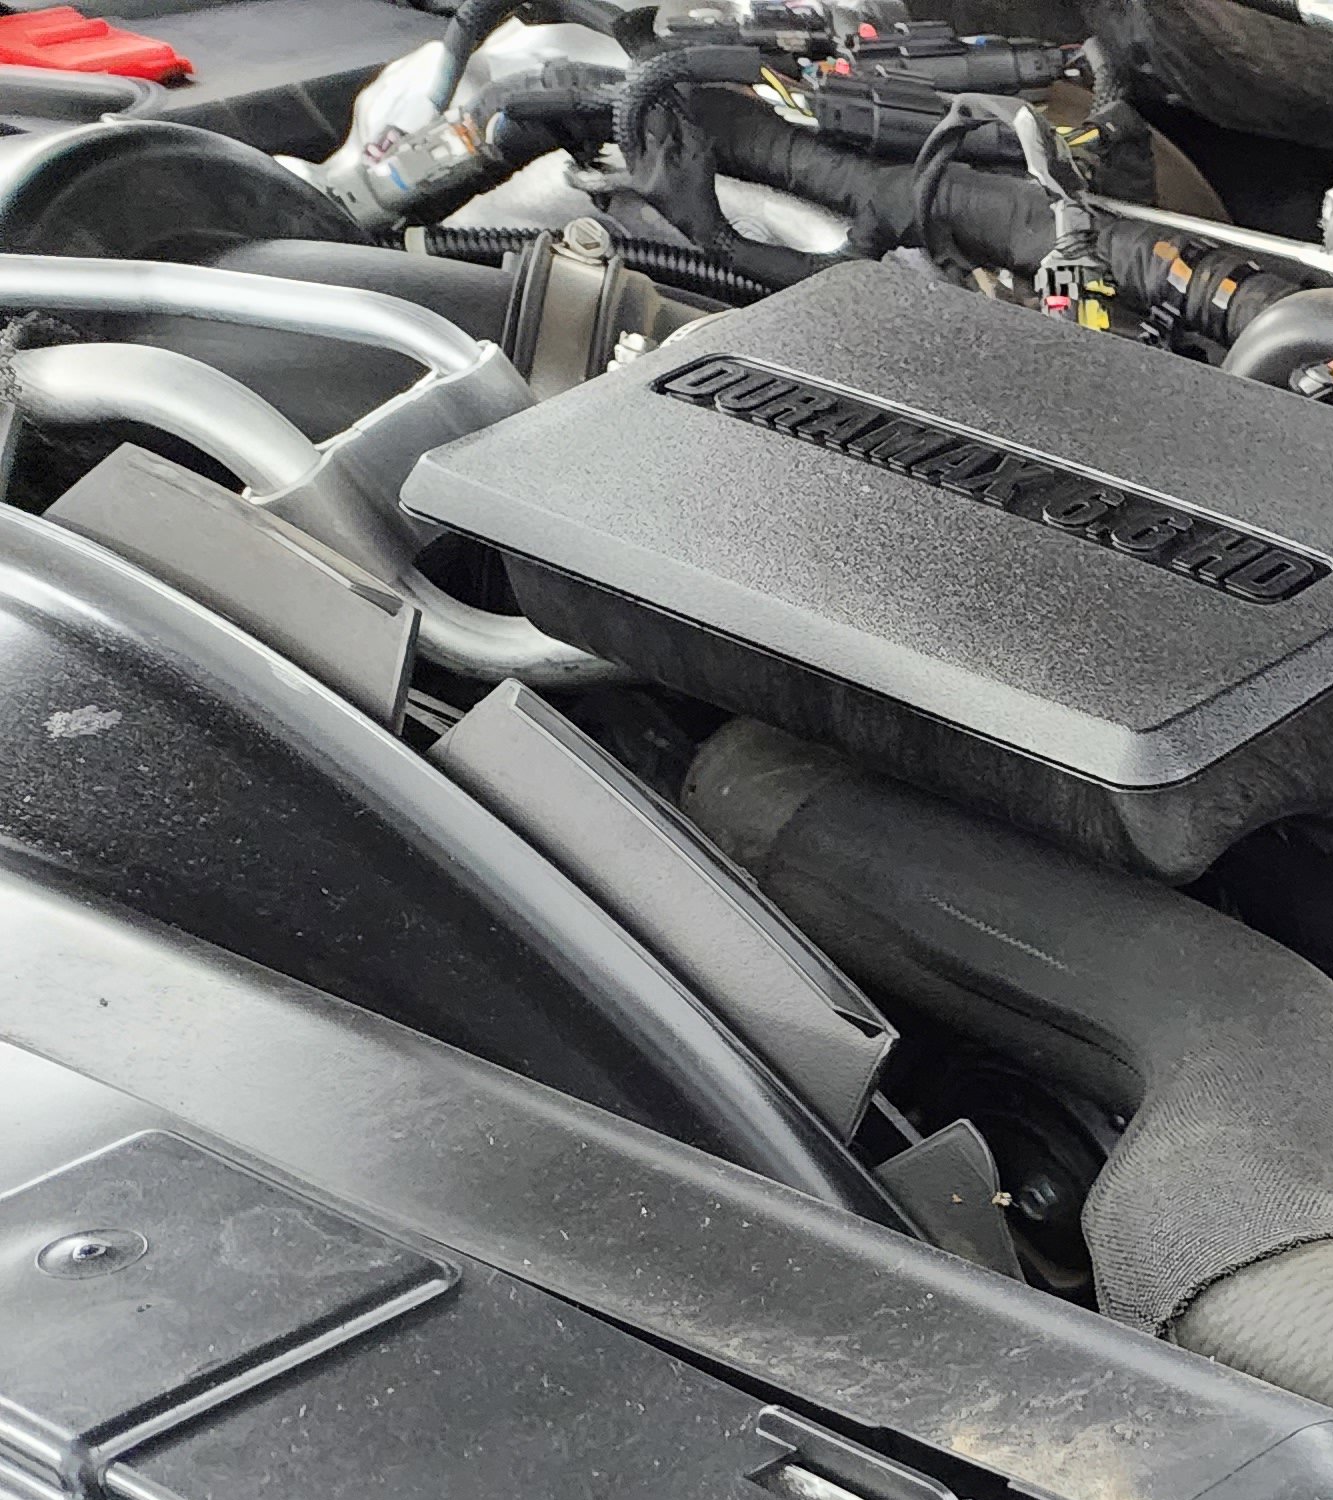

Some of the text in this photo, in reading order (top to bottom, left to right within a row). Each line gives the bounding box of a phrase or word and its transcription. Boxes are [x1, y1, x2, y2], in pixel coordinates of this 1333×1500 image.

[664, 359, 1316, 604] DURAMAX 6.6 HD
